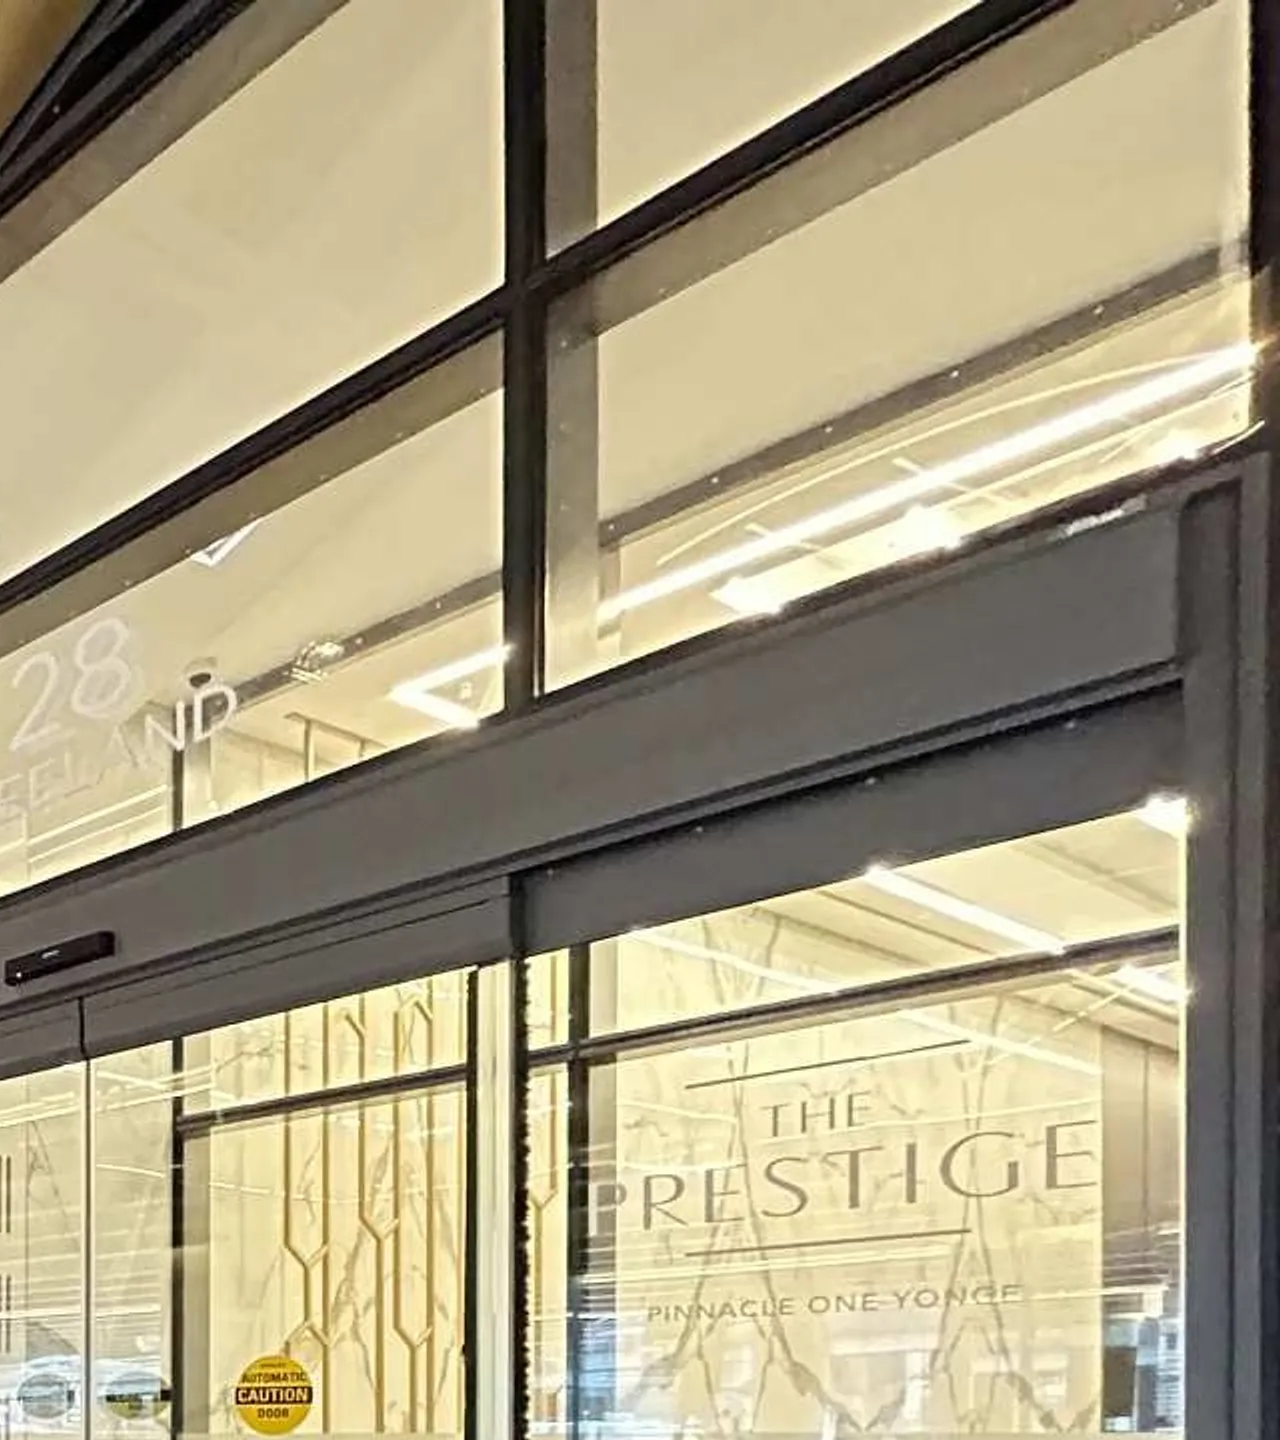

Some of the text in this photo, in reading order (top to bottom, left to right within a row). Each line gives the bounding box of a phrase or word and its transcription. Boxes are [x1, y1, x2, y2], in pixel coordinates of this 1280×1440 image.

[9, 617, 130, 752] 28
[761, 1090, 871, 1138] THE
[590, 1119, 1098, 1236] PRESTIGE
[647, 1284, 1024, 1322] PINNACLE ONE YONGE
[237, 1387, 309, 1402] CAUTION
[242, 1372, 307, 1382] AUTOMATIC
